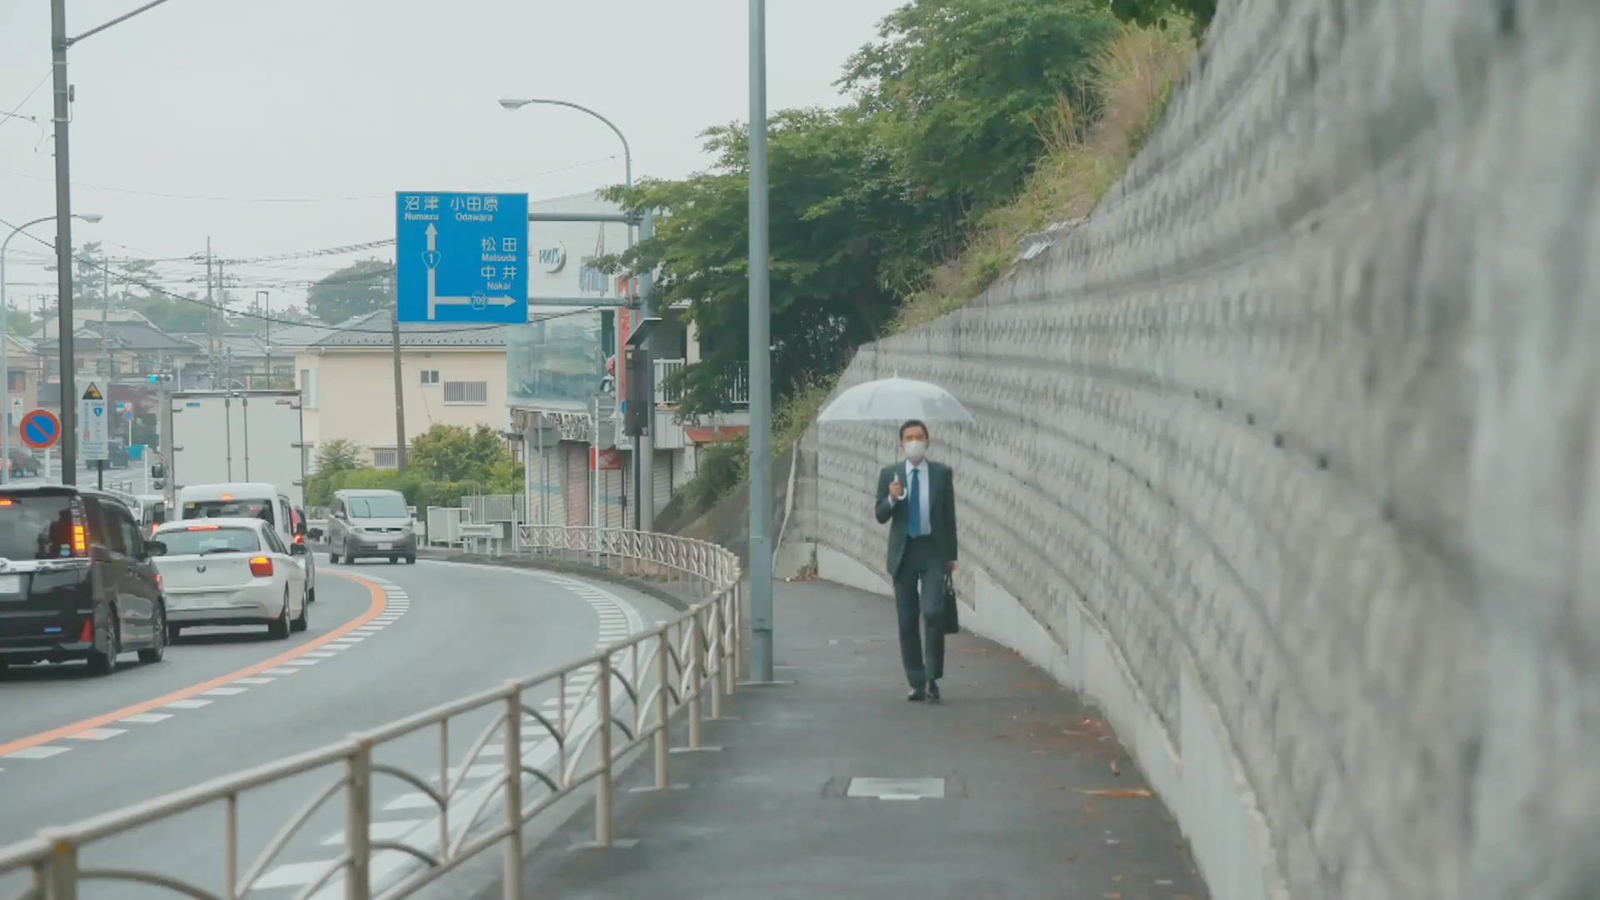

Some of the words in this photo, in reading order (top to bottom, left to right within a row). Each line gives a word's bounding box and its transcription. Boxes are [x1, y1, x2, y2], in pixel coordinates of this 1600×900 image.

[404, 195, 439, 210] 沼津
[450, 196, 499, 212] 小田原
[404, 212, 439, 221] Numazu
[455, 212, 494, 222] Odawara
[481, 236, 517, 252] 松田
[481, 253, 517, 262] Matsuda
[481, 265, 517, 280] 中井
[487, 282, 511, 291] Nakai
